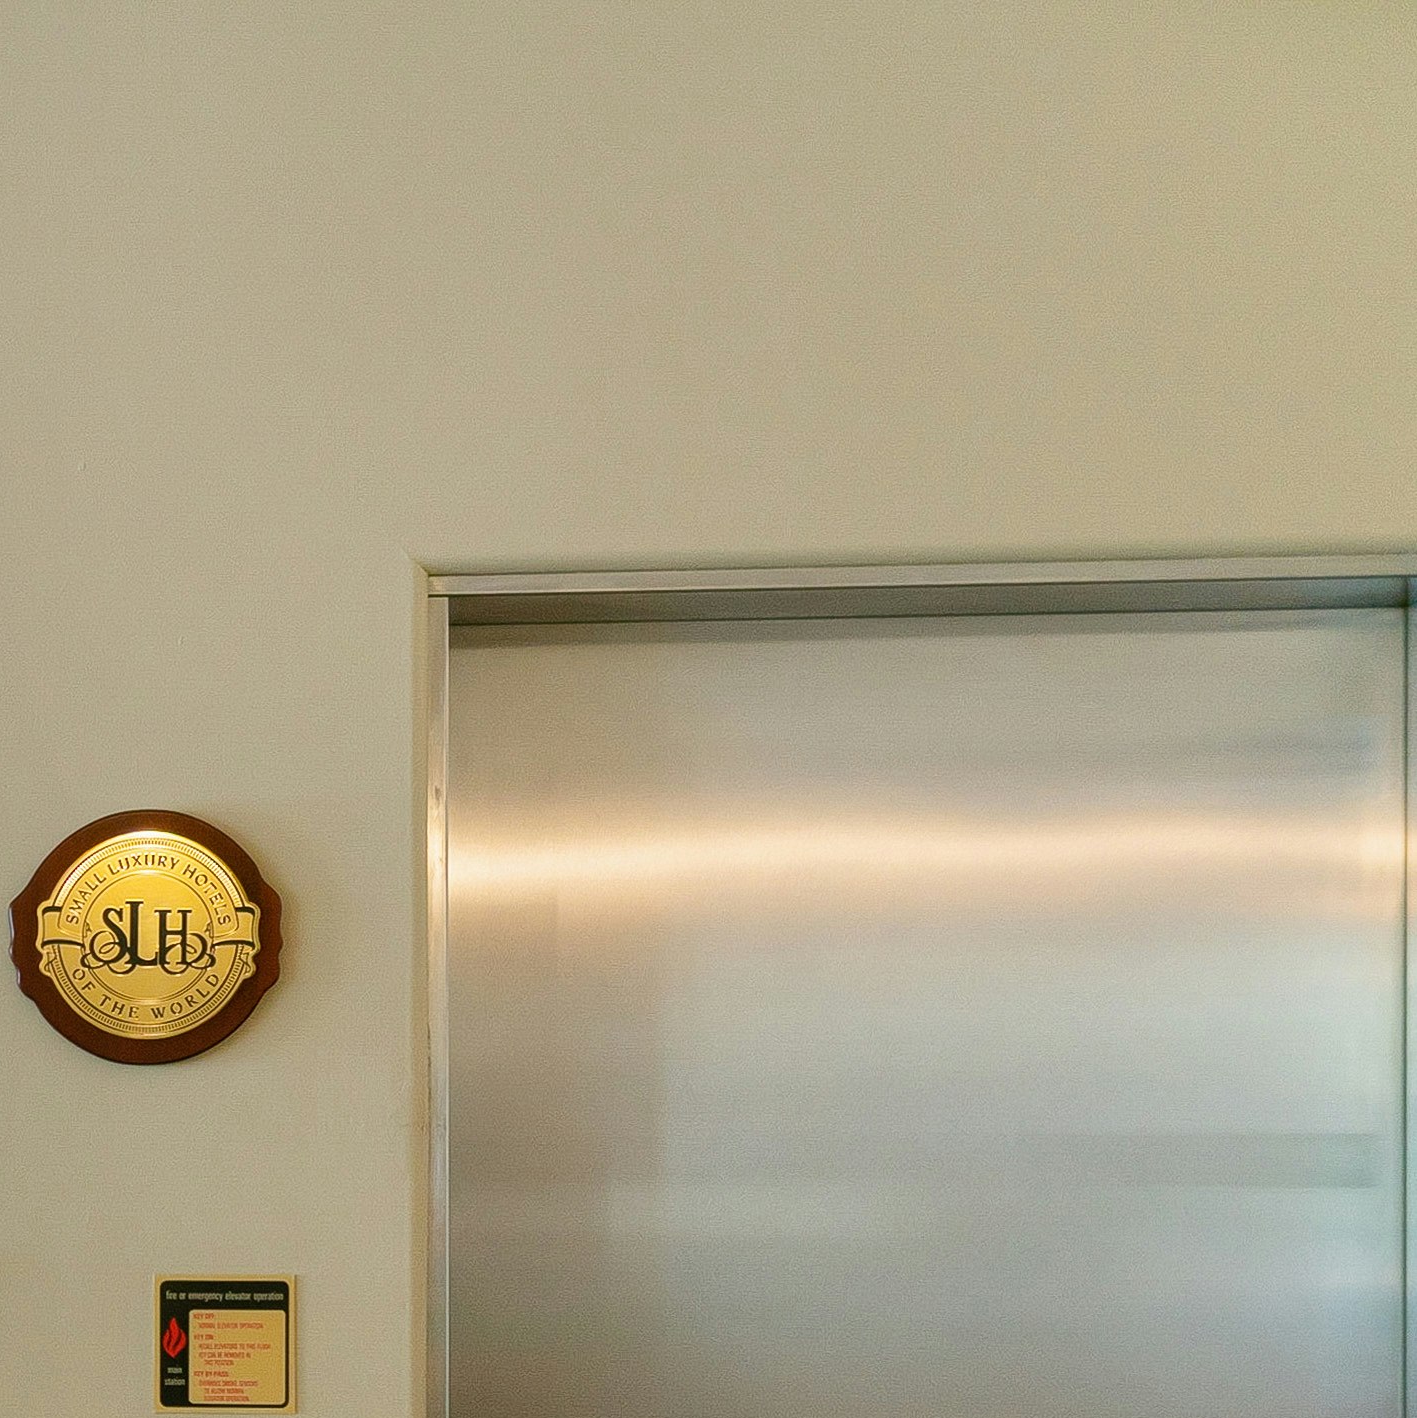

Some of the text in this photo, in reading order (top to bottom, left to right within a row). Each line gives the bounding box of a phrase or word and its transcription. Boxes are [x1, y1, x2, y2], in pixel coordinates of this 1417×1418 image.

[65, 854, 232, 926] SMALL LUXURY HOTELS
[81, 900, 215, 975] SLH
[72, 968, 220, 1019] OF THE WORLD
[166, 1290, 284, 1302] fire or emergency elevator operation
